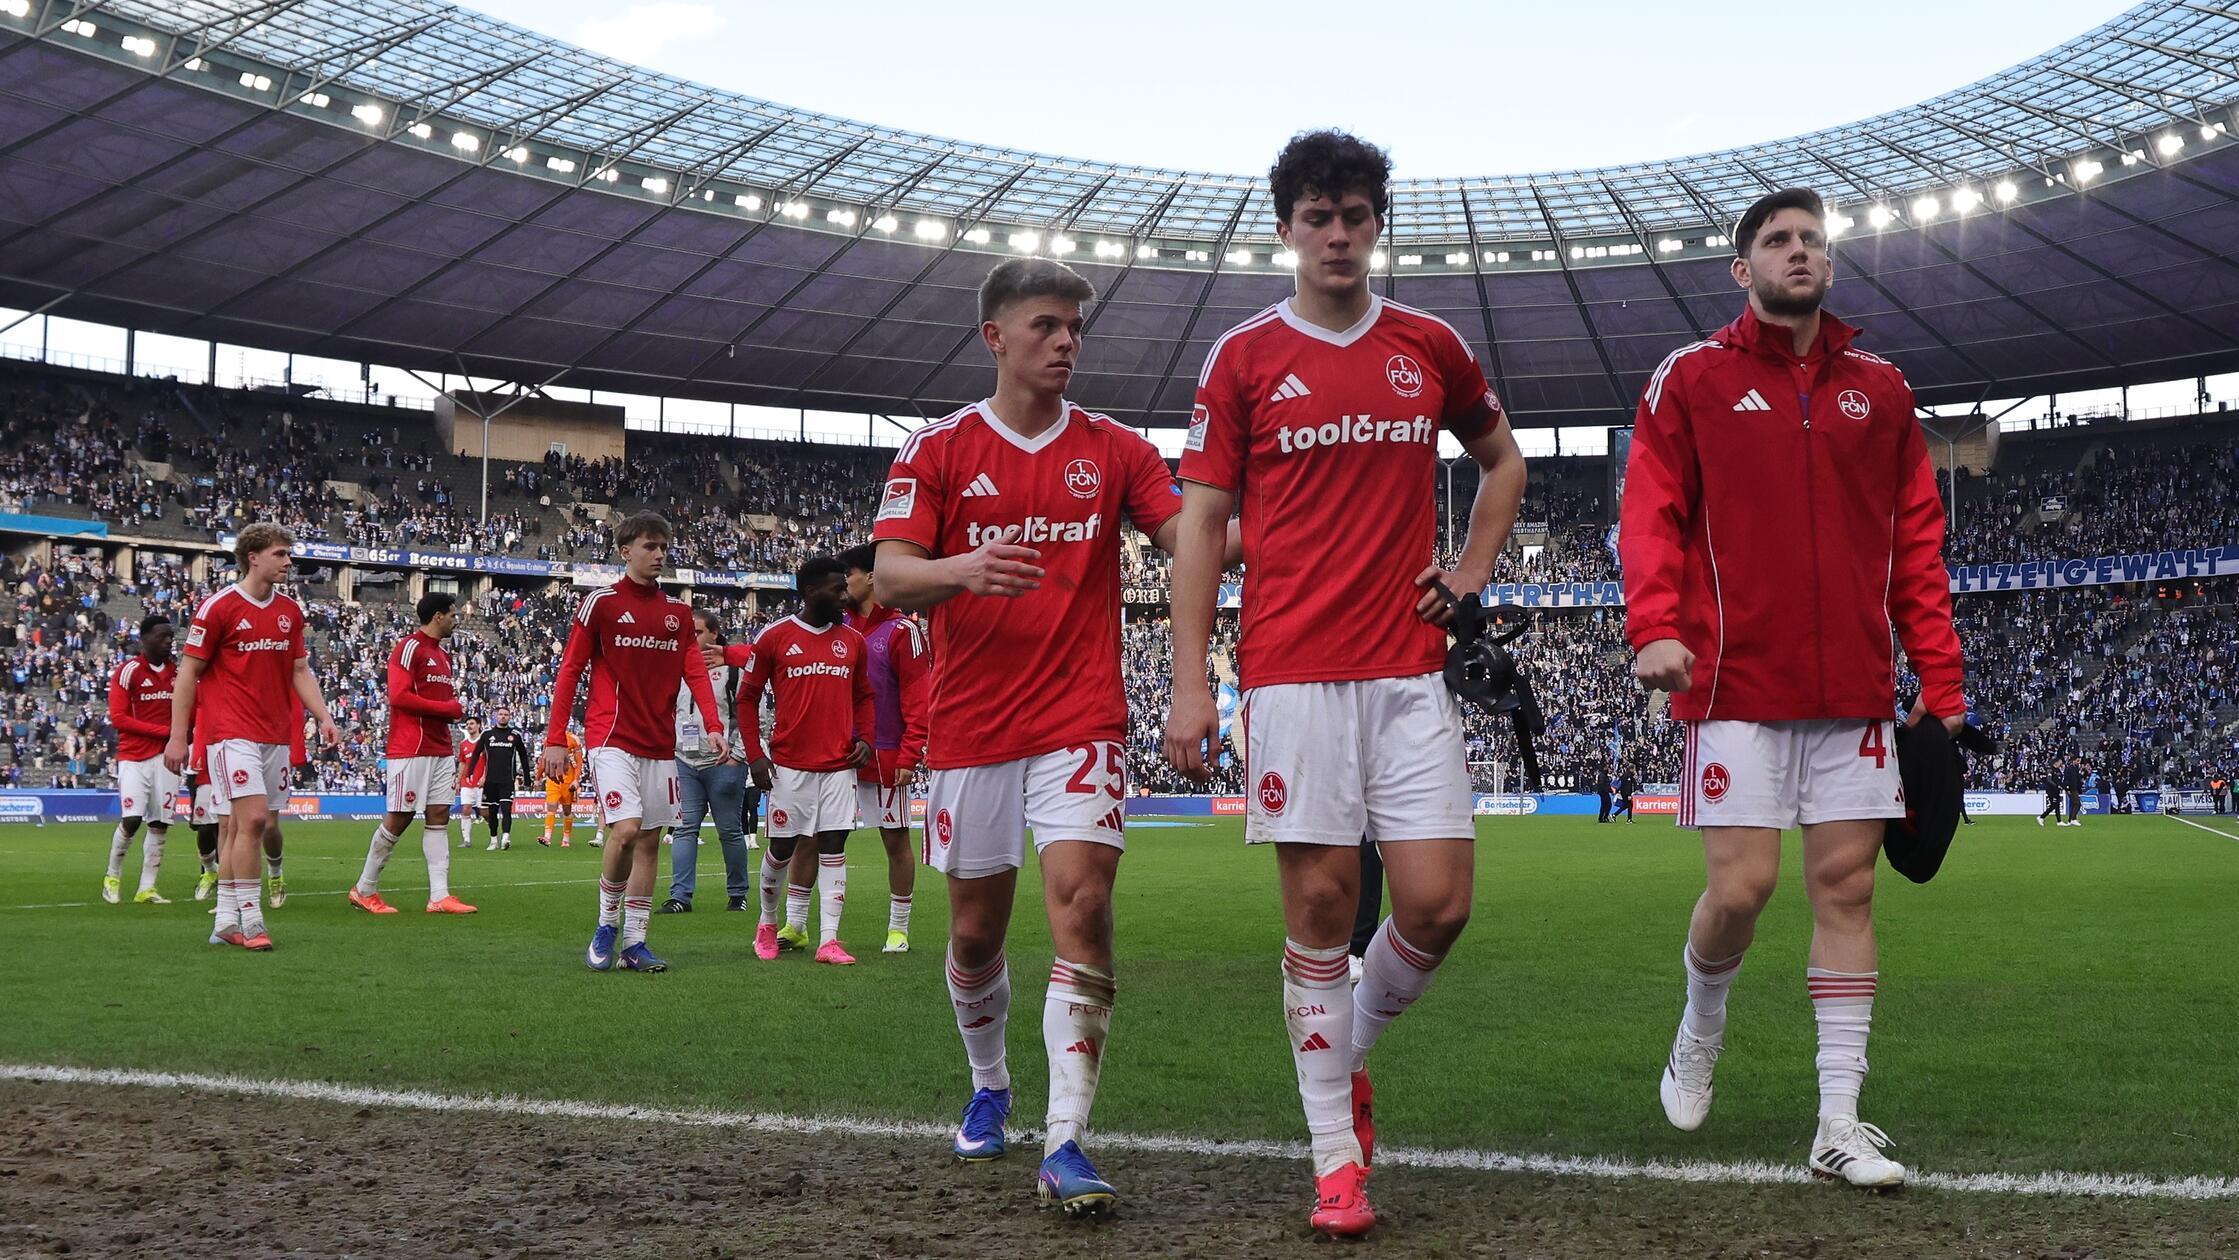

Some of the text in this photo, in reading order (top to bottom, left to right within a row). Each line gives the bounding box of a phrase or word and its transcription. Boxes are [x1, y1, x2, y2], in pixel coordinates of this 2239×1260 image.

[1397, 357, 1408, 371] 1.
[1390, 369, 1419, 385] FCN
[1841, 400, 1866, 414] FCN
[1076, 461, 1087, 473] 1.
[1068, 472, 1097, 486] FCN
[1945, 546, 2225, 592] LIZEIGEWALT
[1065, 741, 1125, 801] 25
[1703, 777, 1726, 791] FCN
[1261, 788, 1284, 803] FCN
[1636, 800, 1678, 810] karriere
[1287, 1003, 1326, 1020] FCN
